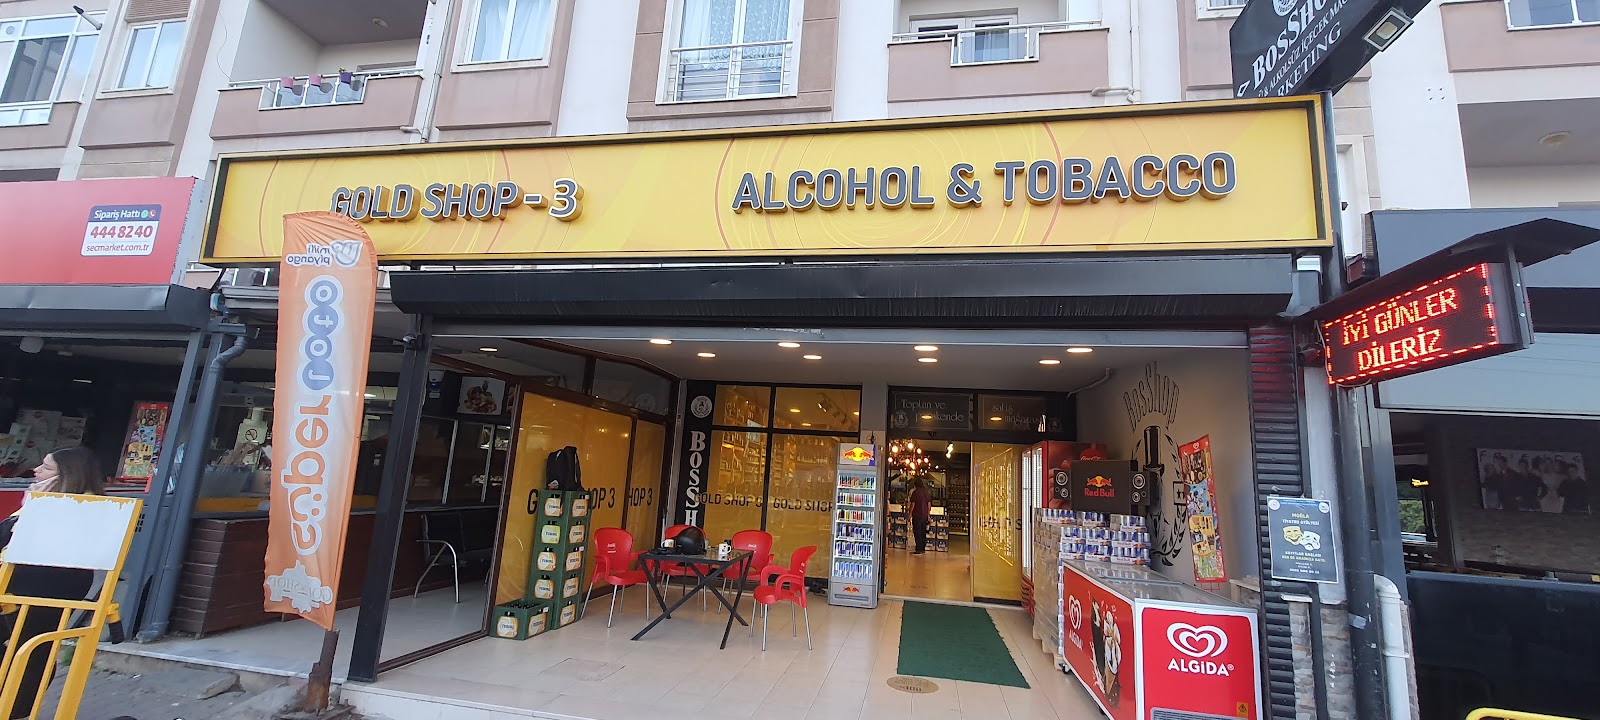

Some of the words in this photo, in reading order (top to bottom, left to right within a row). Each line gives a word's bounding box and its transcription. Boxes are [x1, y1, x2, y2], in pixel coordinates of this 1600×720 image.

[330, 183, 415, 220] GOLD
[420, 180, 519, 219] SHOP
[549, 177, 578, 218] 3
[731, 164, 935, 212] ALCOHOL
[946, 162, 984, 206] &
[994, 150, 1238, 202] TOBACCO
[93, 209, 120, 221] Sipariş
[120, 209, 140, 219] Hattı
[86, 243, 150, 252] secmarket.com.tr
[1342, 312, 1369, 345] İYİ
[1373, 287, 1458, 335] GÜNLER
[1357, 325, 1443, 372] DİLERİZ
[1084, 488, 1098, 496] Red
[1100, 488, 1115, 497] Bull
